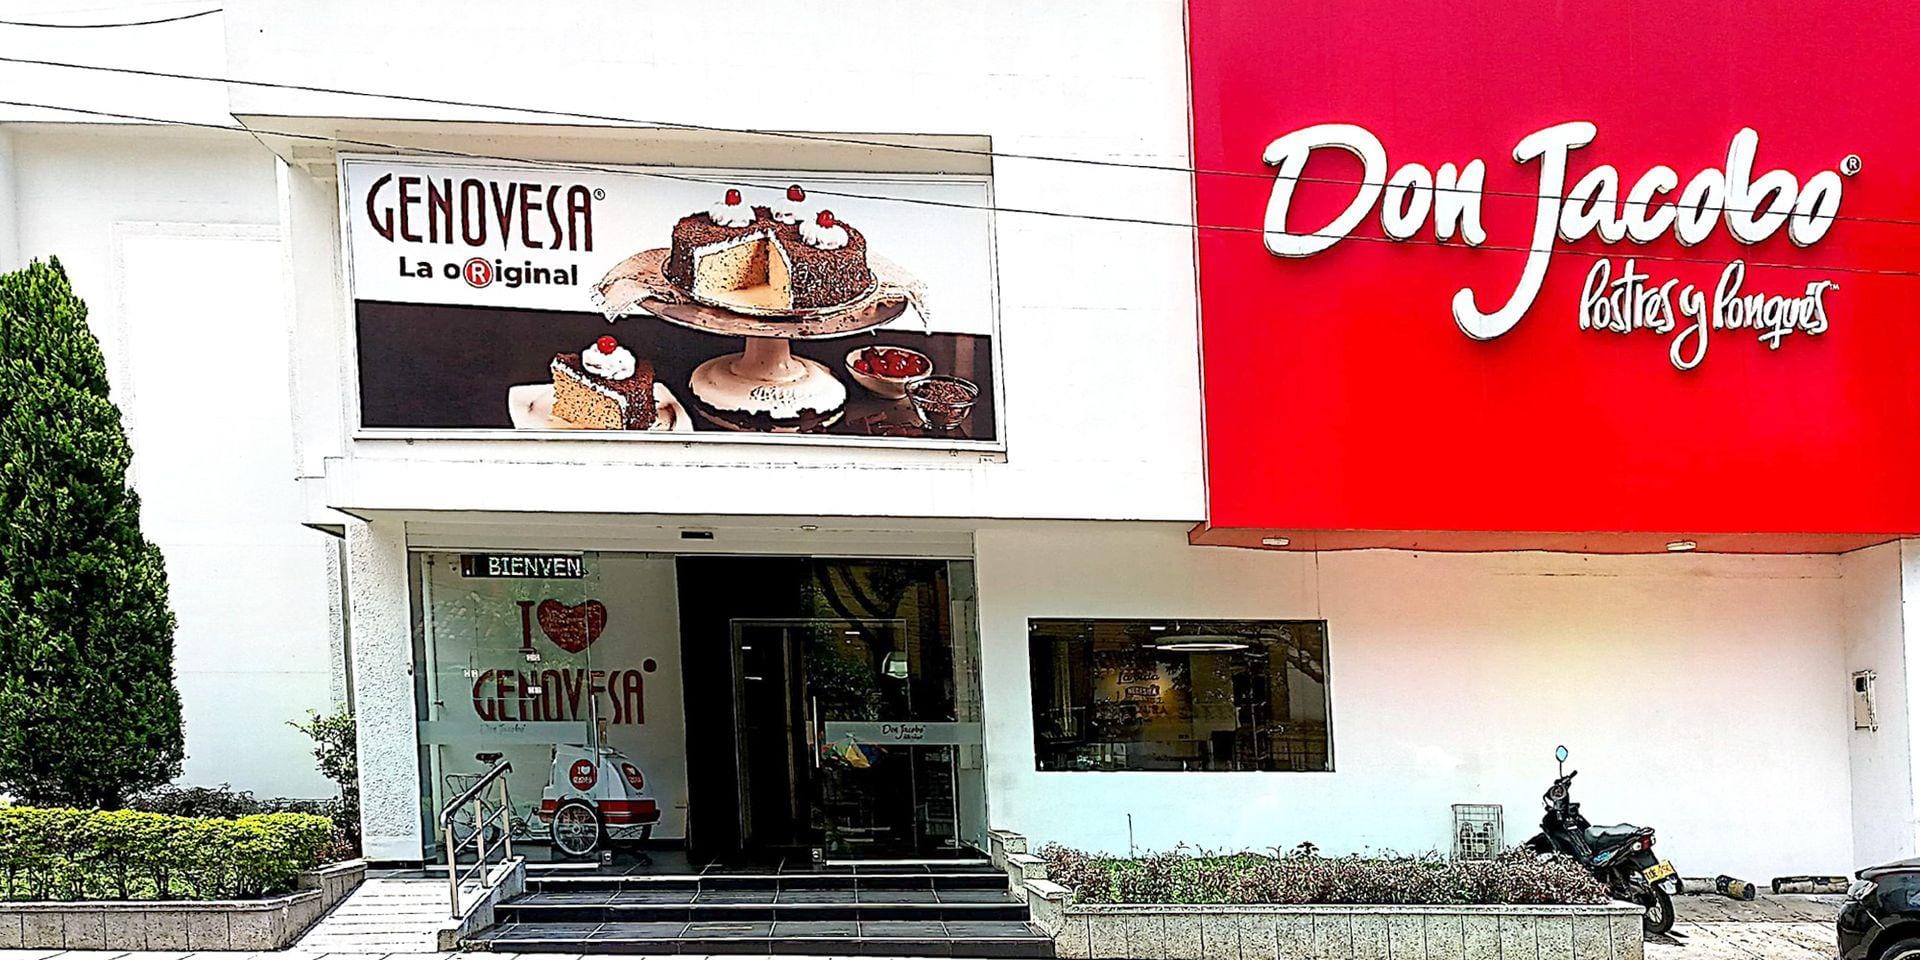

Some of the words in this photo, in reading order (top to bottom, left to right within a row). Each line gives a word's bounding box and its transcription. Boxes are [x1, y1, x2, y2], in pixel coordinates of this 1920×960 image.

[366, 172, 593, 252] GENOVESA
[1263, 122, 1487, 258] Don
[1452, 120, 1844, 341] Jacobo
[399, 256, 433, 278] La
[444, 256, 578, 289] oRiginal
[1579, 257, 1680, 335] Postres
[1669, 284, 1709, 371] y
[488, 556, 581, 577] BIENVEN
[516, 600, 537, 654] I
[472, 667, 645, 725] GENOVESA
